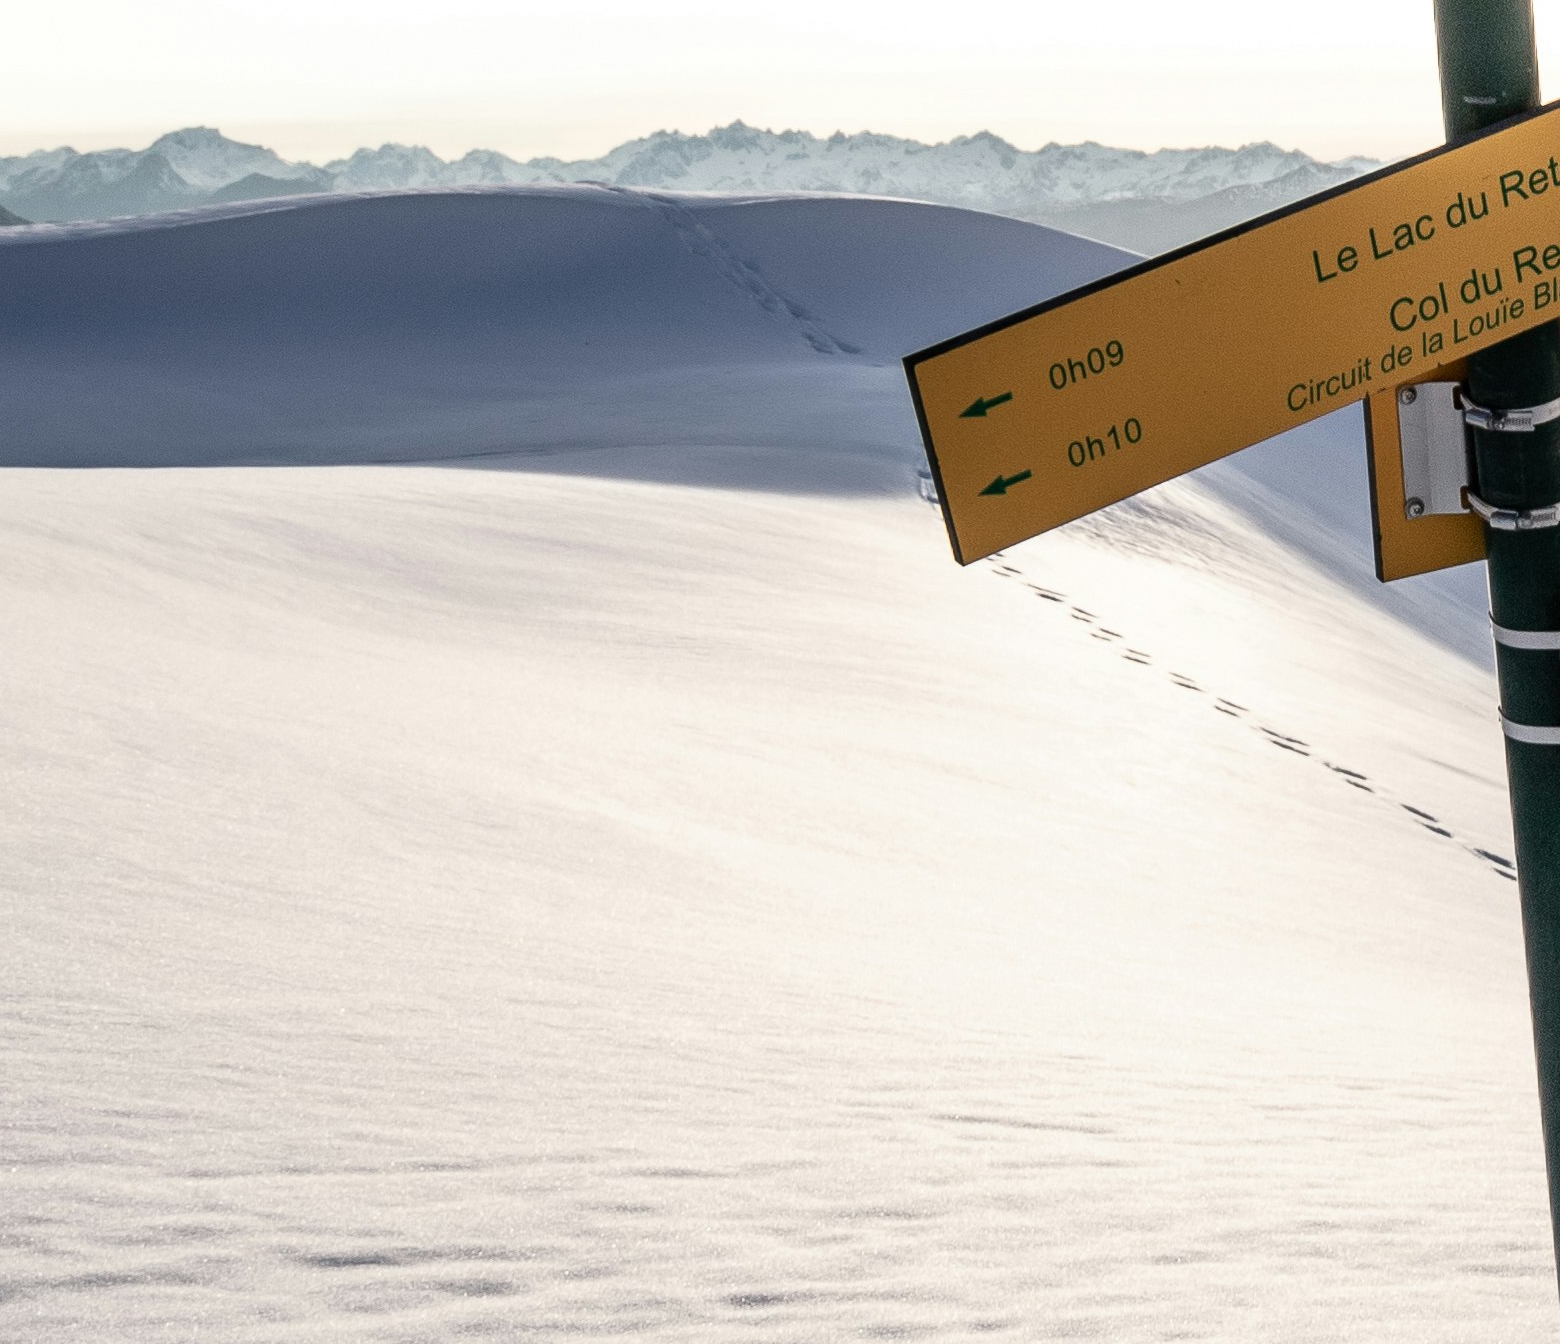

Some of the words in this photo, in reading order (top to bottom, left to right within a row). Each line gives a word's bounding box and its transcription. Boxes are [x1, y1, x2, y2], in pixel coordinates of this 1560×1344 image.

[1312, 246, 1359, 284] Le
[1369, 214, 1436, 261] Lac
[1445, 192, 1490, 229] du
[1389, 281, 1450, 332] Col
[1460, 268, 1503, 305] du
[1048, 339, 1124, 390] 0h09
[1286, 357, 1372, 413] Circuit
[1380, 341, 1413, 374] de
[1422, 331, 1444, 357] la
[1453, 298, 1525, 345] Louïe
[1067, 417, 1142, 467] 0h10
